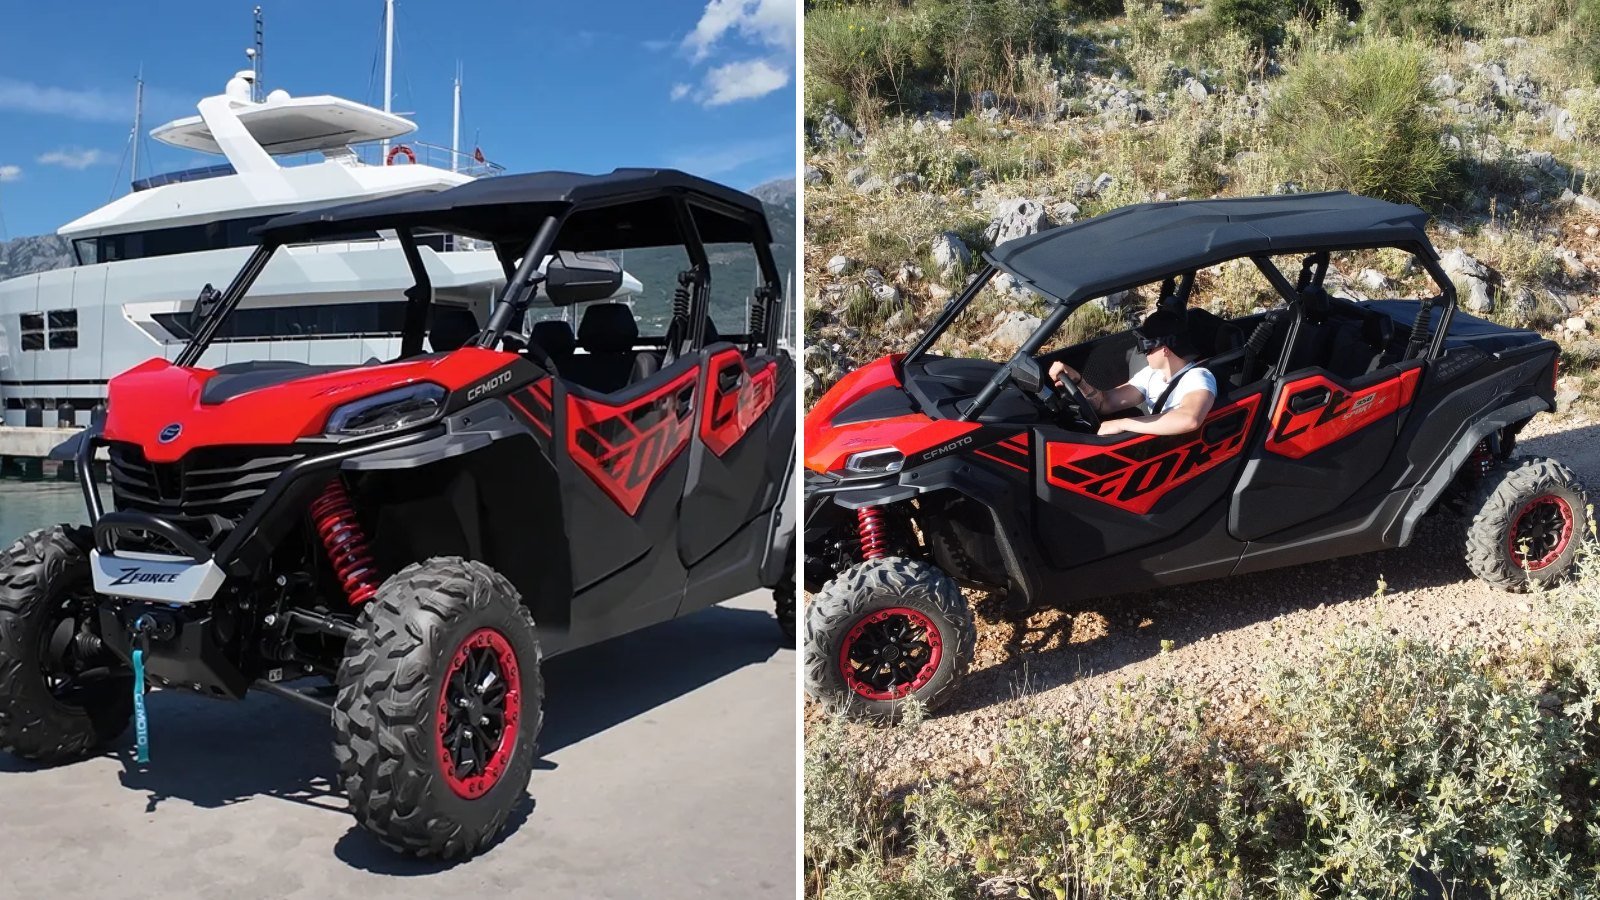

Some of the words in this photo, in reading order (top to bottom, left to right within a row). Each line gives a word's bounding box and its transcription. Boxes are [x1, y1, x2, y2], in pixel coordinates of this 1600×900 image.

[466, 370, 513, 401] CFMOTO
[922, 436, 973, 461] CFMOTO
[135, 693, 148, 745] CFMOTO
